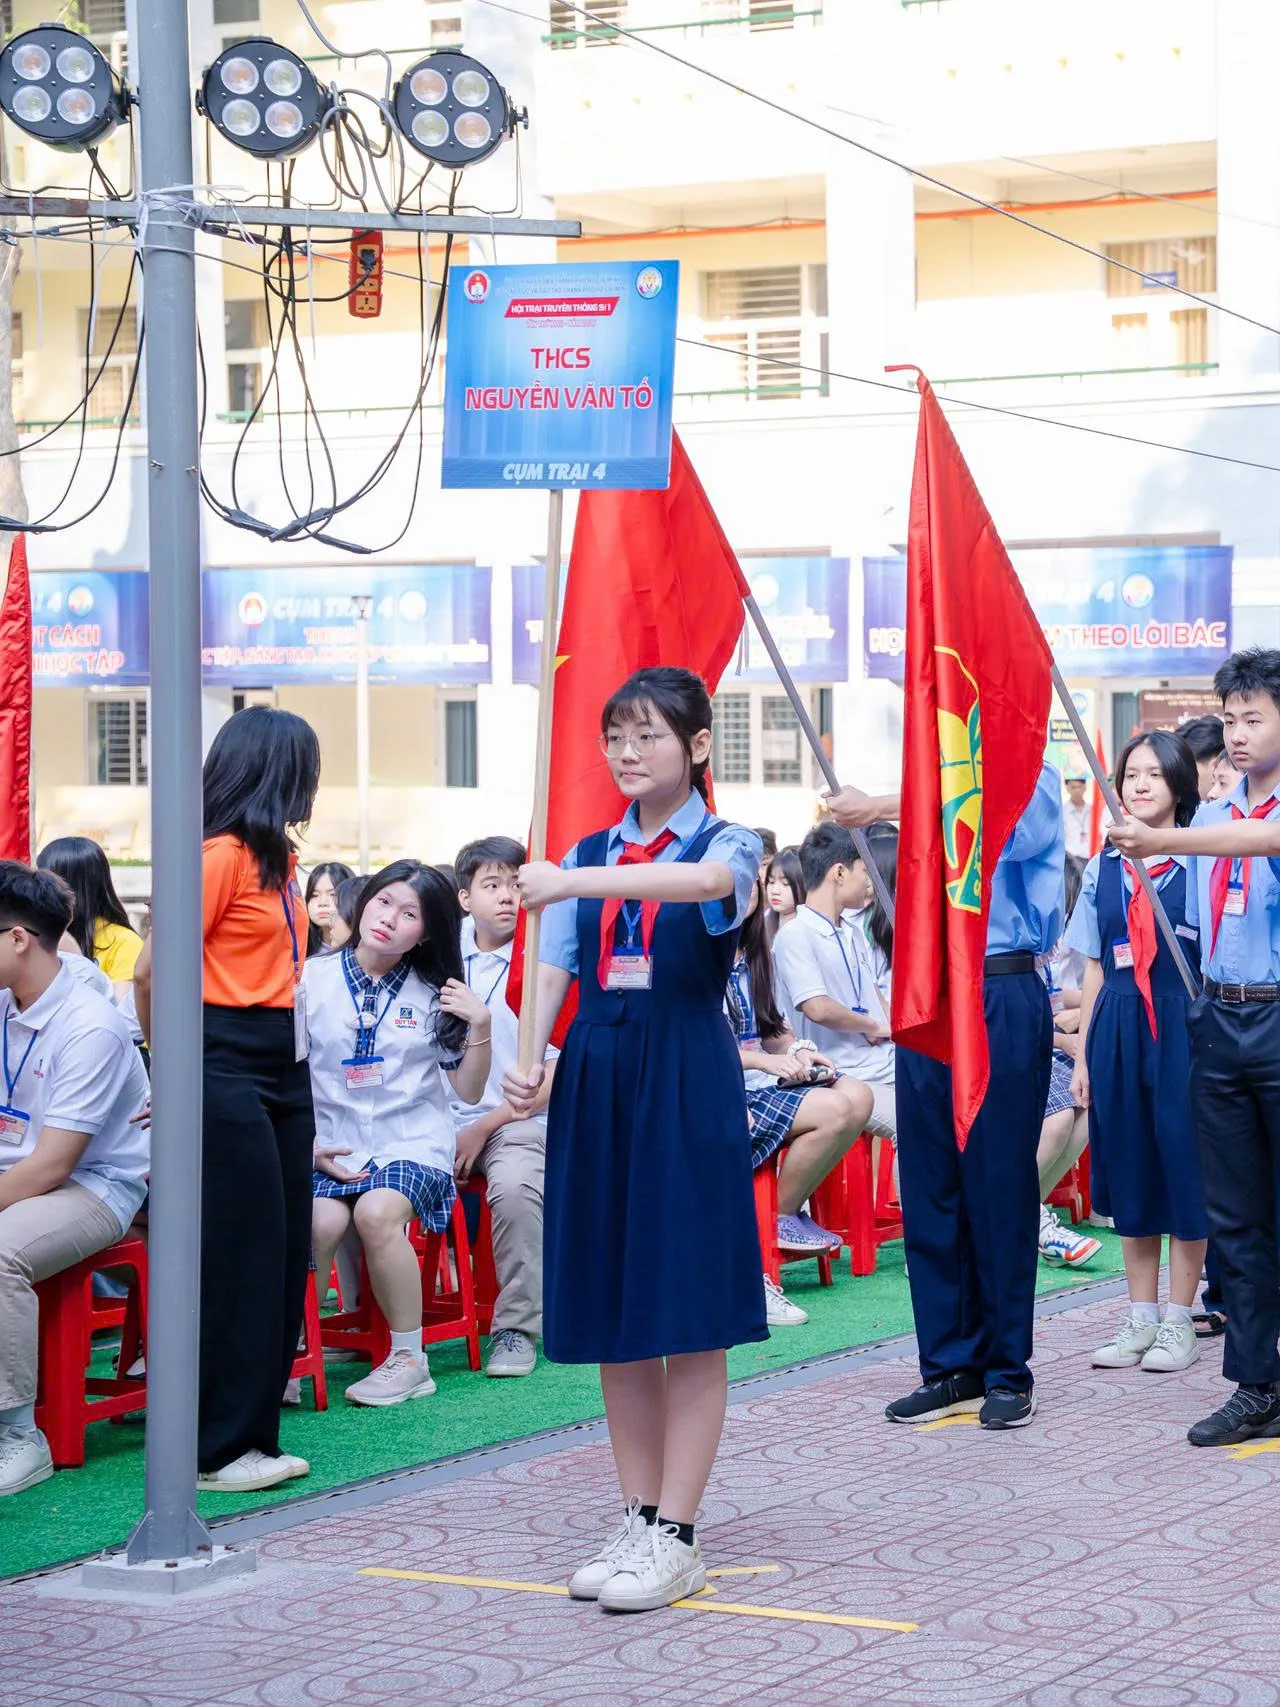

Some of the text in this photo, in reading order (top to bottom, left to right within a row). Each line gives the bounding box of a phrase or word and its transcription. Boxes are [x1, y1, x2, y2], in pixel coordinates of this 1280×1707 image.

[531, 347, 591, 369] THCS
[465, 376, 653, 410] NGUYỄN VĂN TỐ
[503, 463, 606, 485] CỤM TRẠI 4
[869, 627, 906, 657] HỌ
[1067, 625, 1128, 648] THEO
